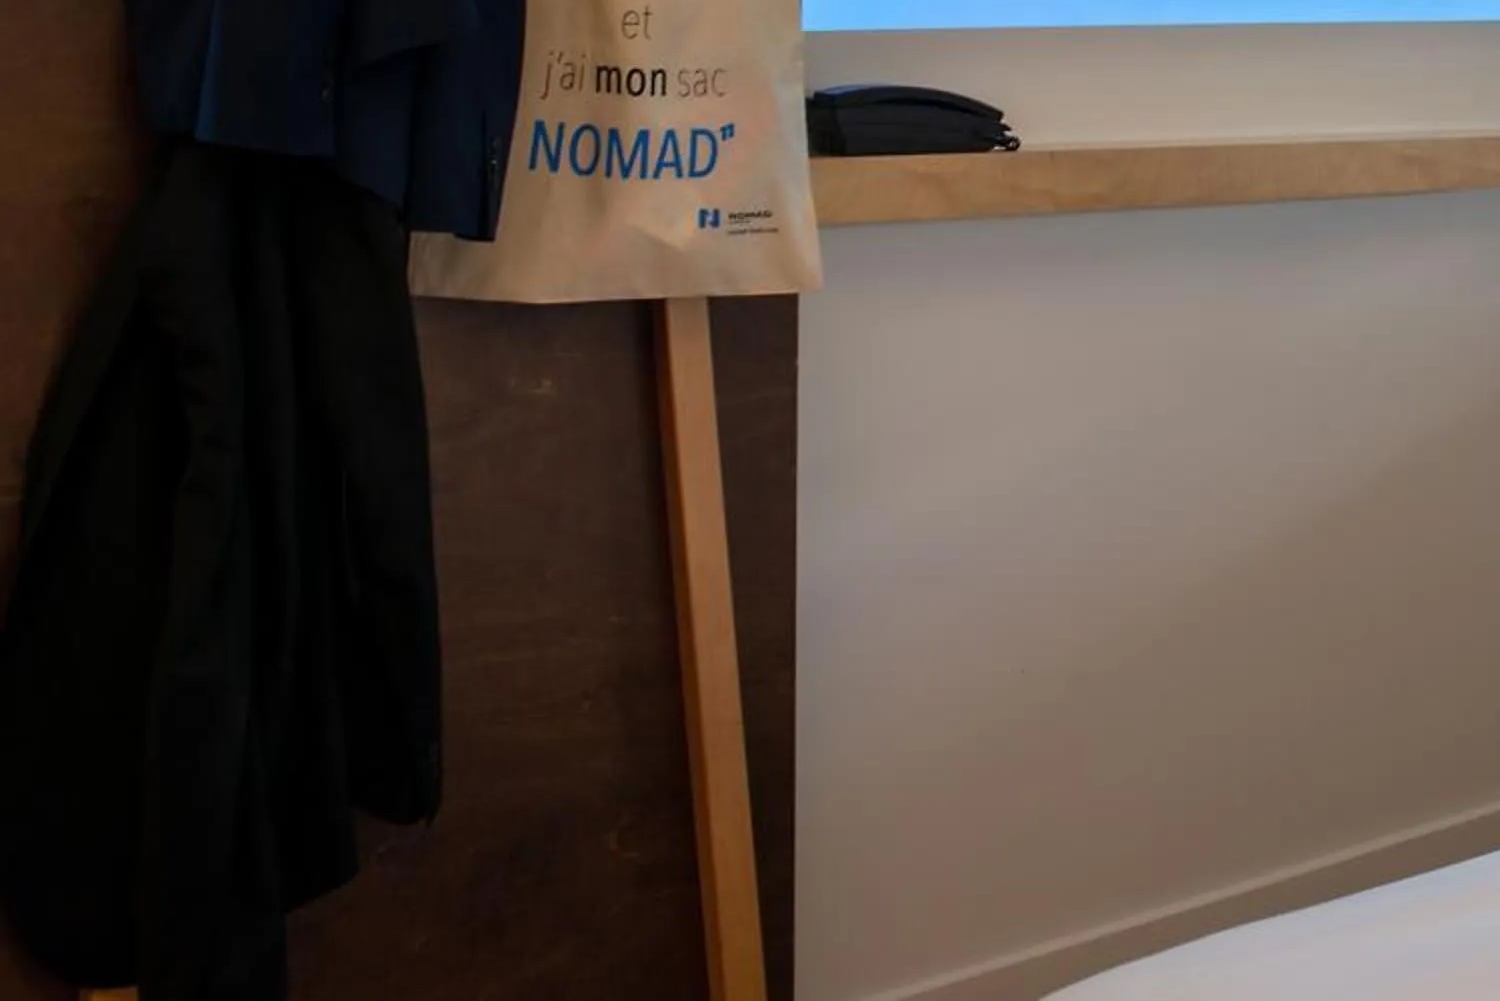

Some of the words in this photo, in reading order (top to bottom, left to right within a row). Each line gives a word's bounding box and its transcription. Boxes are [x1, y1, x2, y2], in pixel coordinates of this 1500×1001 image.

[621, 5, 653, 40] et
[540, 50, 586, 100] j'ai
[595, 65, 667, 97] mon
[677, 67, 728, 98] sac
